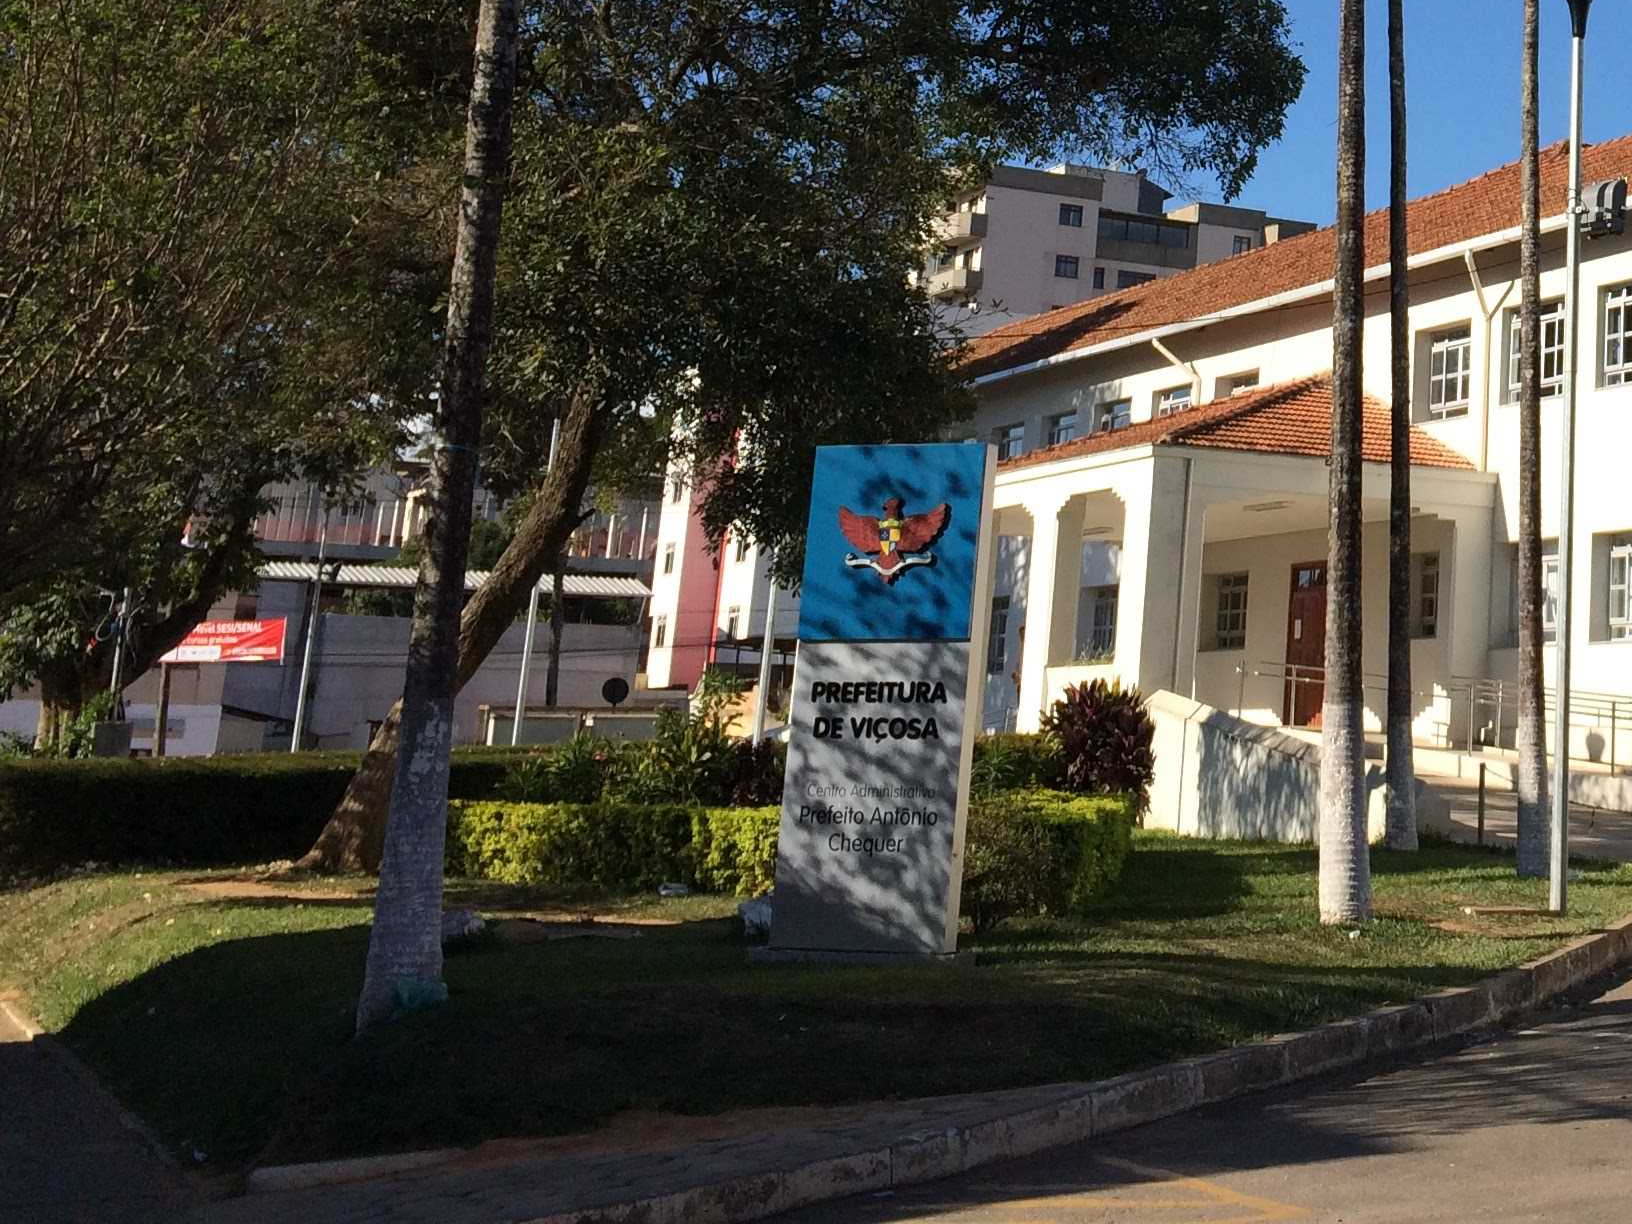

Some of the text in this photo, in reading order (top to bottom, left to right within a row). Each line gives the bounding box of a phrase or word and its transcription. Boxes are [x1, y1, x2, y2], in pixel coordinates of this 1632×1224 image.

[811, 681, 947, 703] PREFEITURA
[813, 717, 939, 744] DE VIÇOSA
[807, 783, 936, 799] Centro Administrativo
[799, 805, 938, 826] Prefeito Antônio
[828, 832, 904, 858] Chequer
